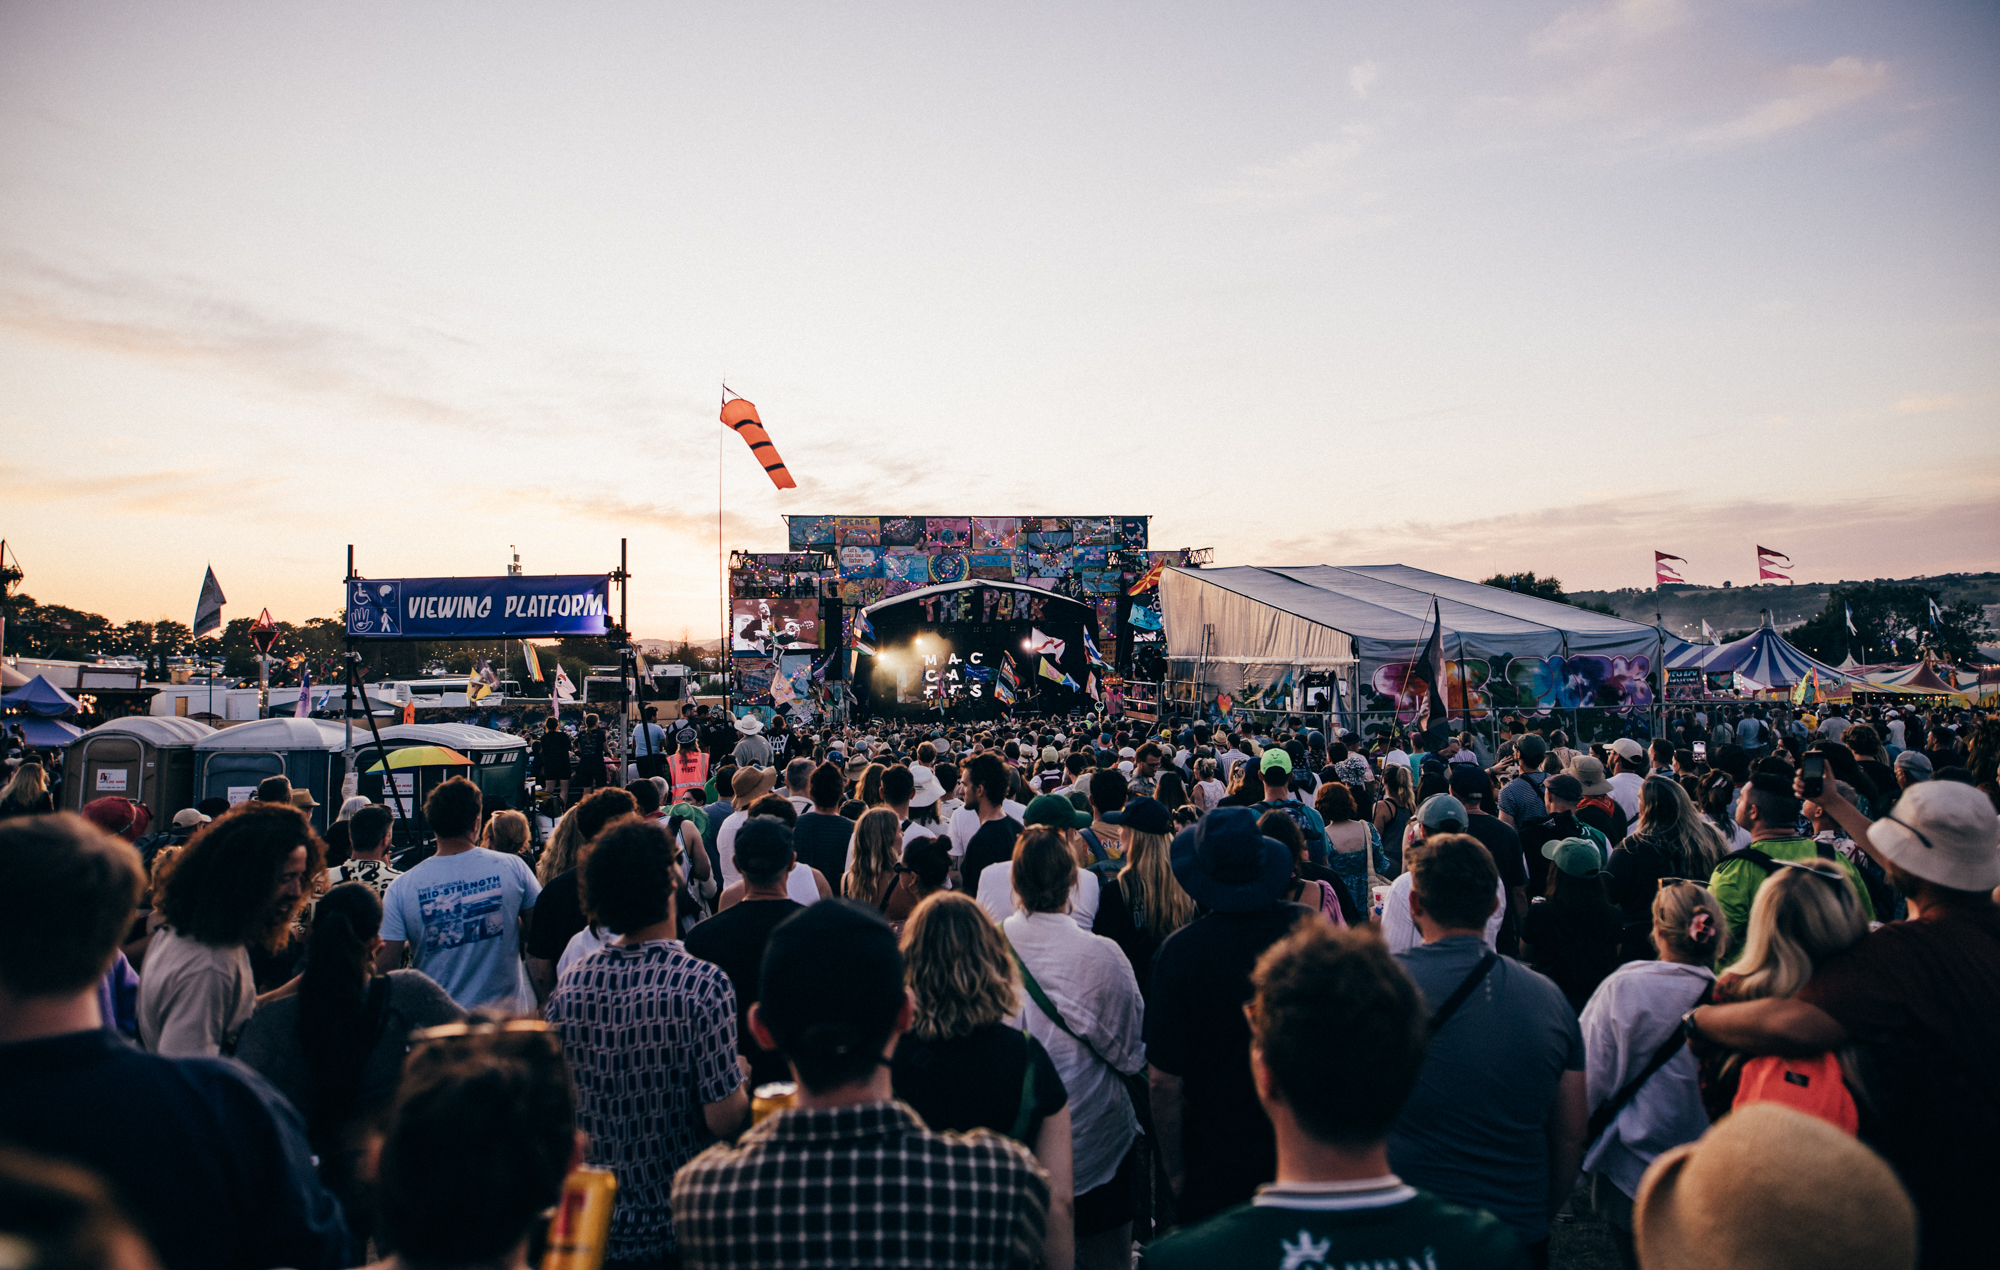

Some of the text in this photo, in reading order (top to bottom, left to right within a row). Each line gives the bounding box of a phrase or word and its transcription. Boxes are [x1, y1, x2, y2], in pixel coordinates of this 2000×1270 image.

[935, 519, 959, 527] ACT
[408, 593, 604, 619] VIEWING PLATFORM
[919, 588, 1048, 622] THE PARK
[417, 879, 467, 895] THE ORIGINAL
[418, 875, 501, 901] MID-STRENGTH
[461, 882, 503, 898] BREWERS
